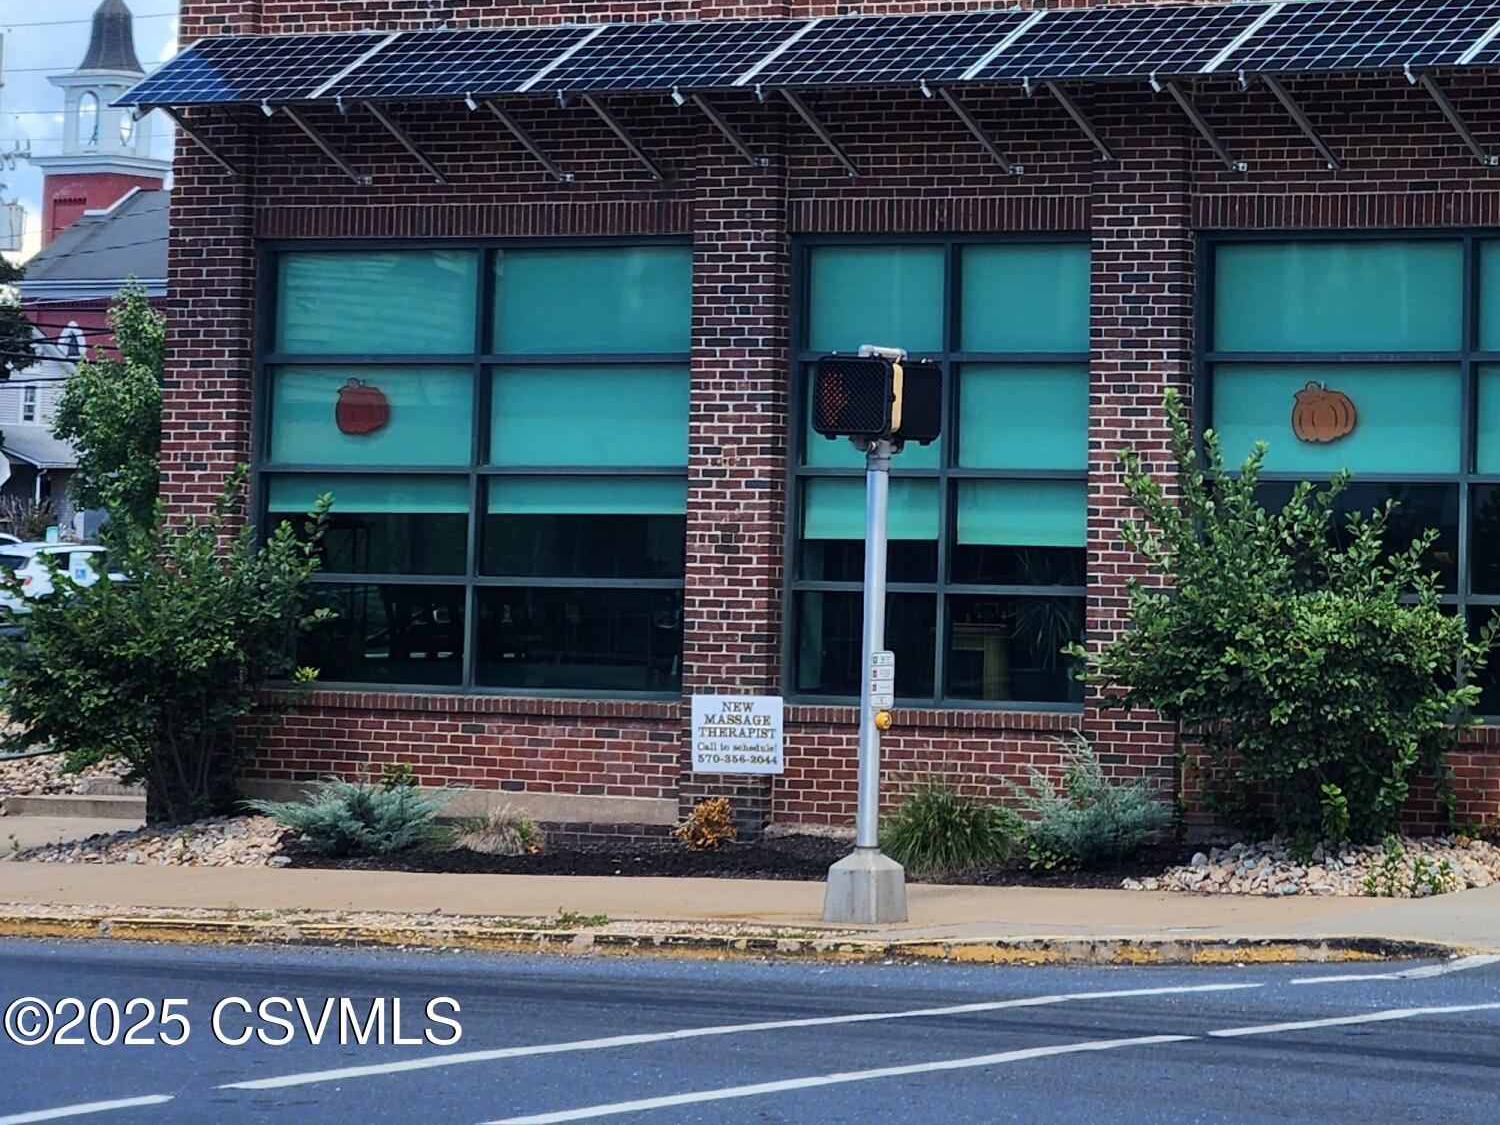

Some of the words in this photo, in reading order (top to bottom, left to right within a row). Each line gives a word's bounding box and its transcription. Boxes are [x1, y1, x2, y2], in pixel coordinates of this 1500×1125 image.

[721, 701, 754, 712] NEW
[703, 713, 771, 726] MASSAGE
[697, 726, 776, 739] THERAPIST
[697, 742, 717, 751] Call
[720, 743, 730, 751] to
[733, 743, 778, 752] schedule!
[697, 754, 778, 764] 570-356-2044
